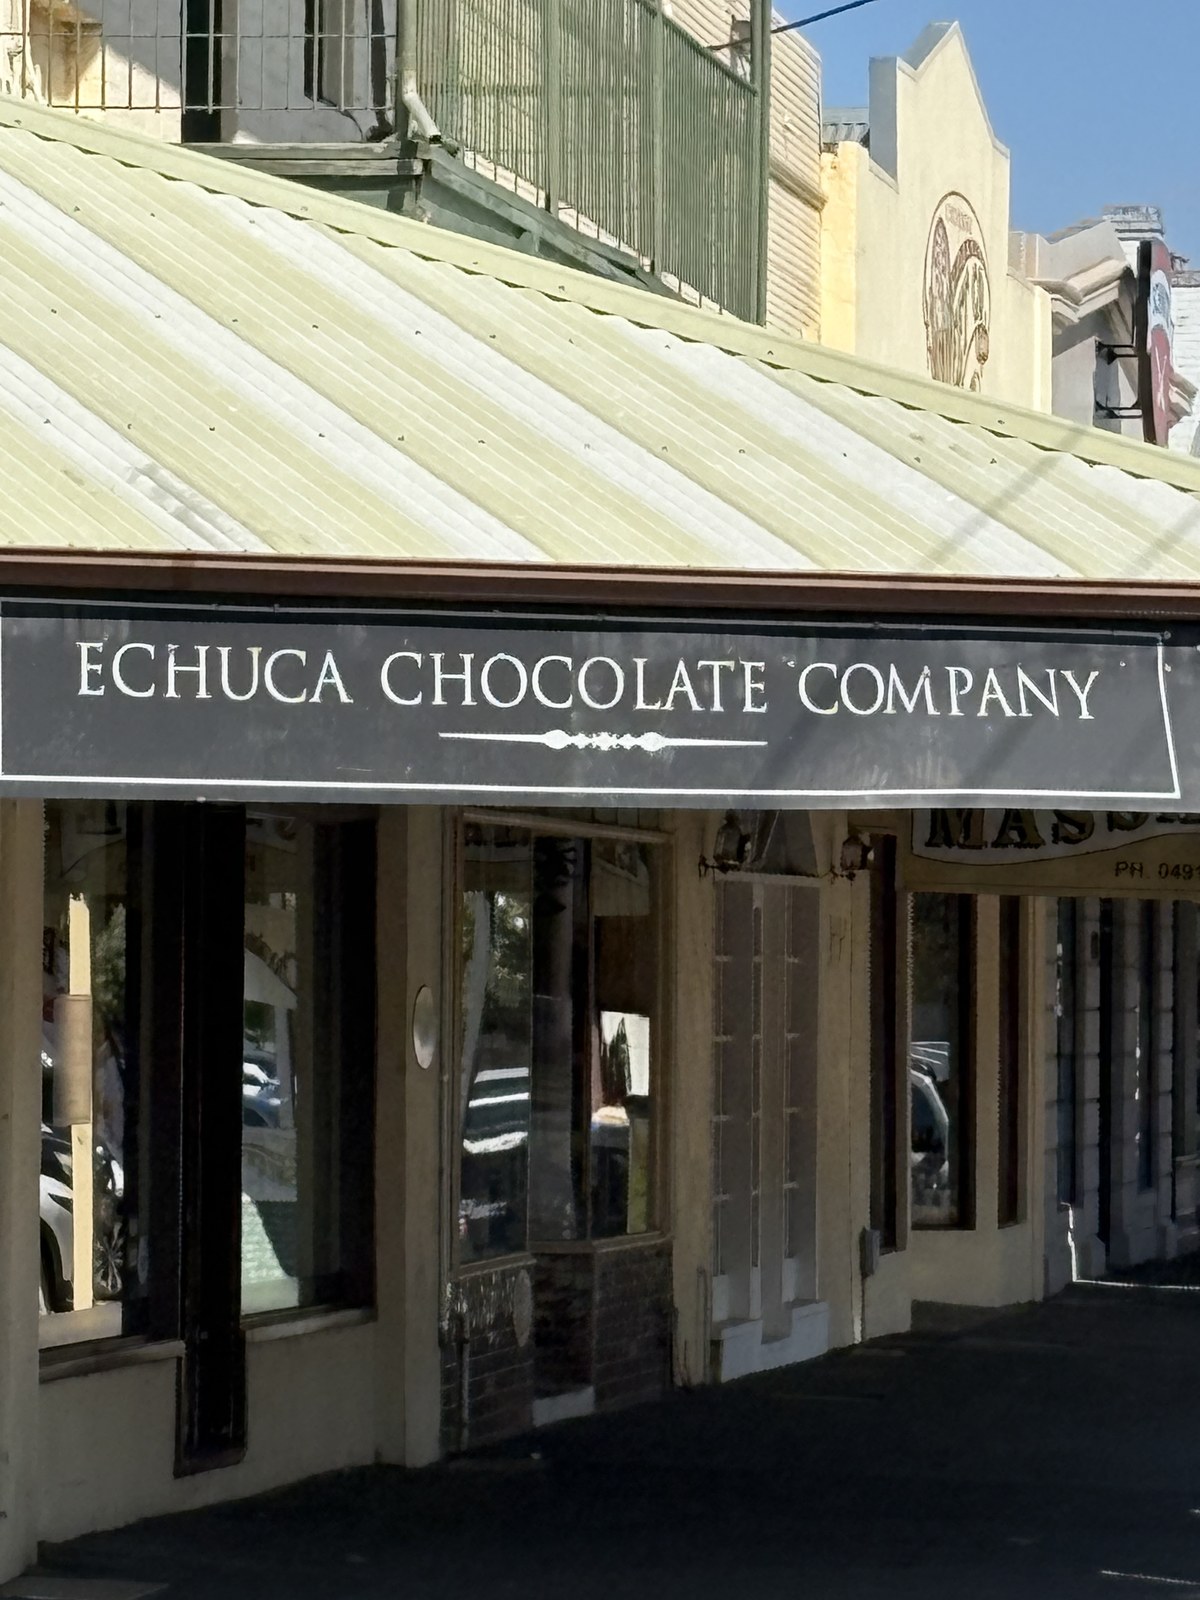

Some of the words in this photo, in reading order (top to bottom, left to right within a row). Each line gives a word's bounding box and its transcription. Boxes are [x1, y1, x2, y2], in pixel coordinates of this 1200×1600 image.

[76, 641, 354, 704] ECHUCA
[380, 651, 768, 712] CHOCOLATE
[798, 662, 1099, 719] COMPANY
